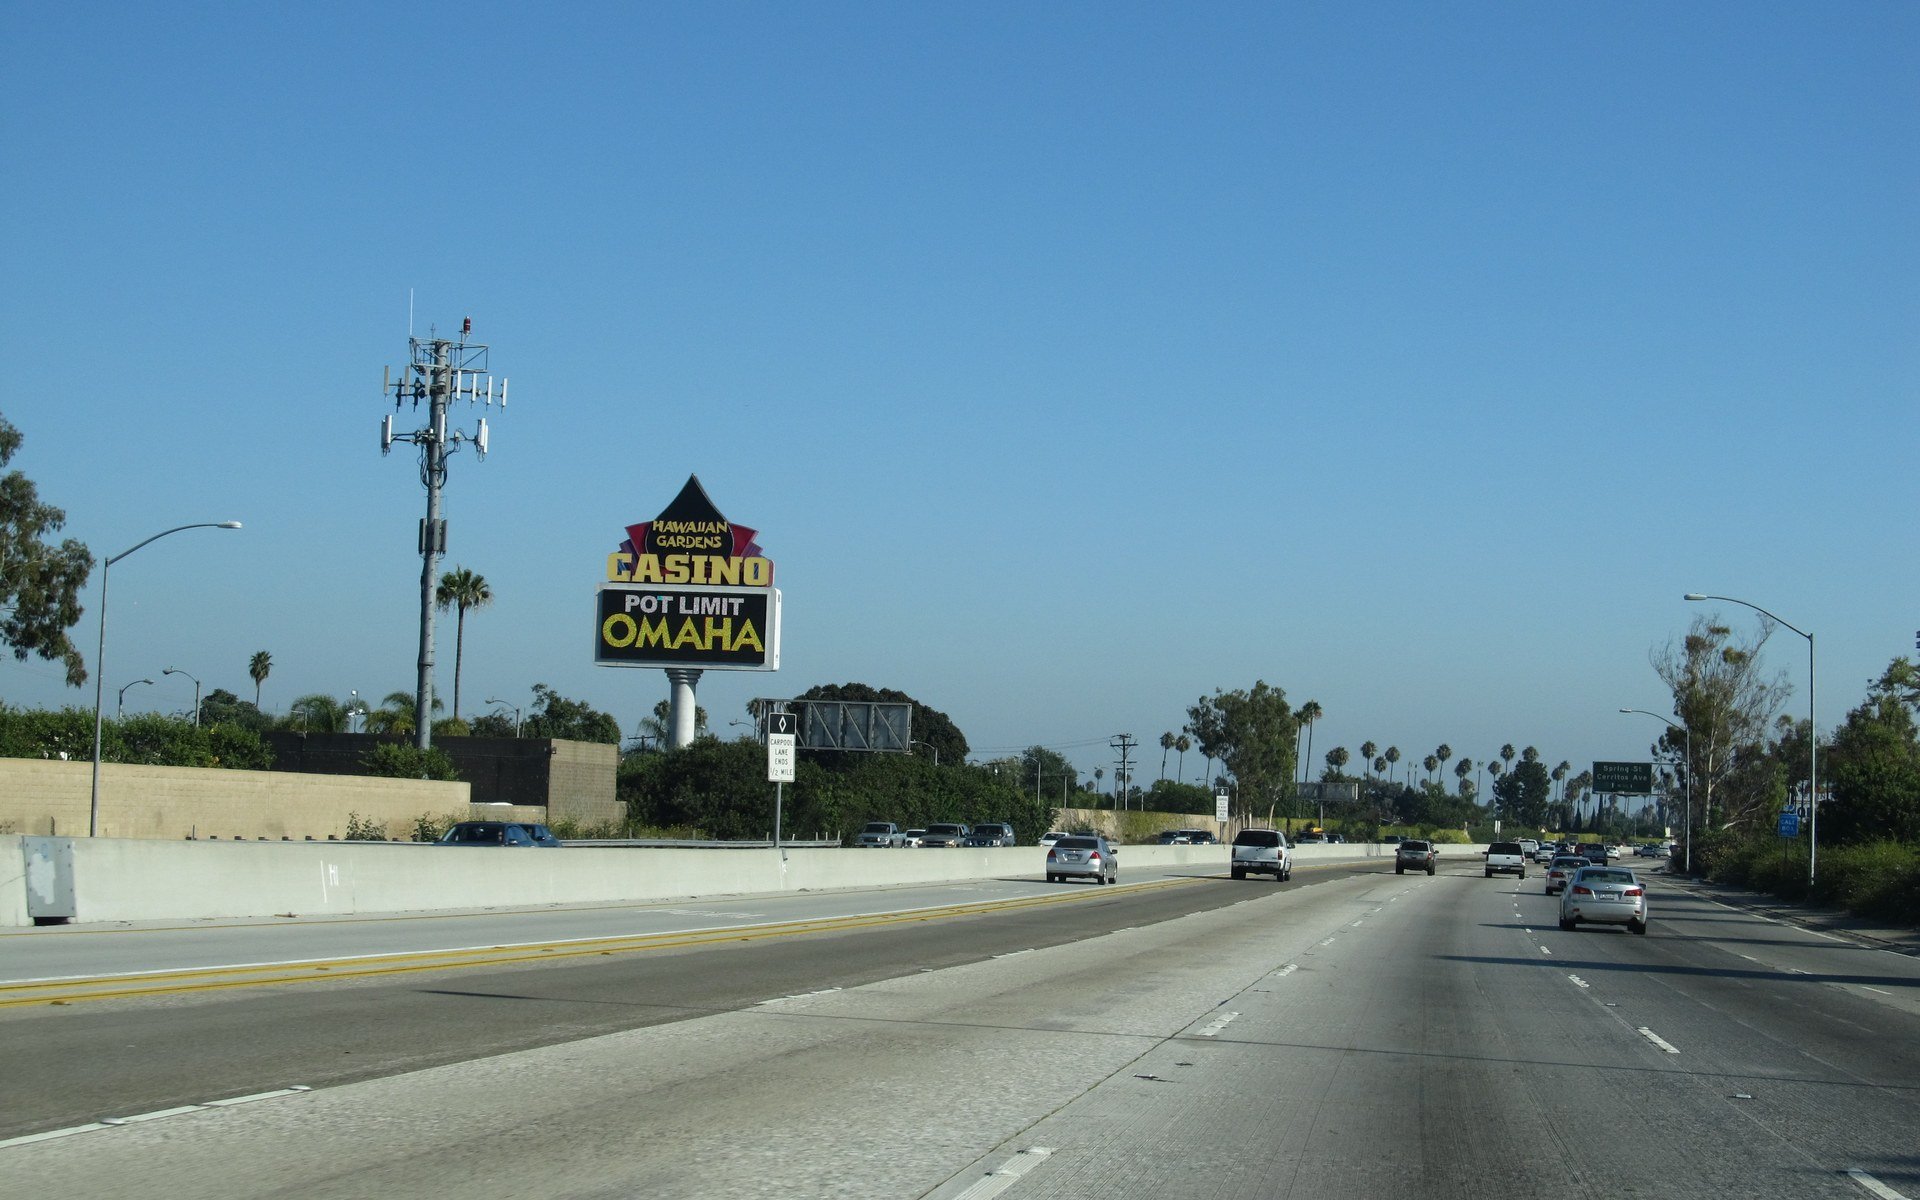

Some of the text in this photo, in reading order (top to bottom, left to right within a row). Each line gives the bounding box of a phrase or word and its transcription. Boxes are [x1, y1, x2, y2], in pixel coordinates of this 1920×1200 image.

[652, 520, 728, 534] HAWAIIAN
[656, 535, 722, 549] GARDENS
[607, 552, 771, 586] CASINO
[625, 595, 744, 616] POT LIMIT
[602, 613, 764, 652] OMAHA
[770, 738, 793, 746] CARPOOL
[775, 748, 788, 756] LANE
[775, 758, 788, 766] ENDS
[781, 768, 793, 776] MILE
[1603, 765, 1629, 773] Spring
